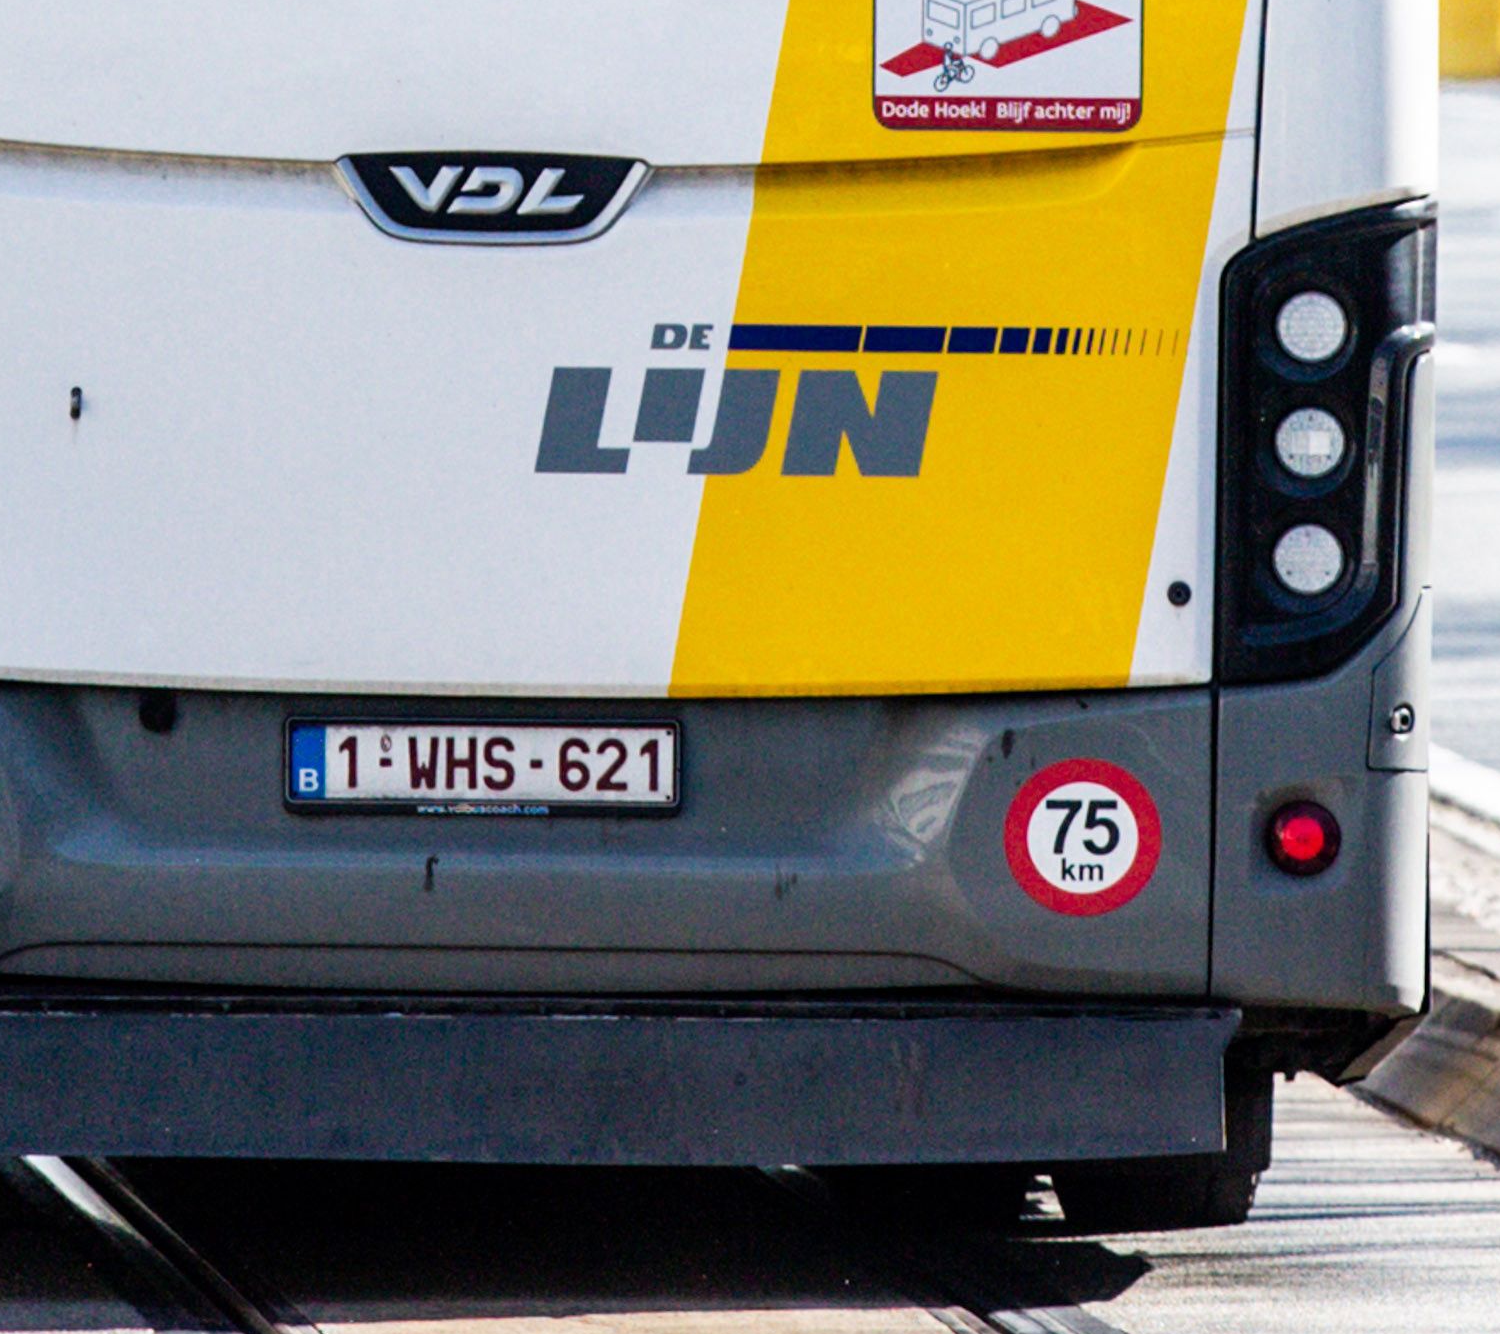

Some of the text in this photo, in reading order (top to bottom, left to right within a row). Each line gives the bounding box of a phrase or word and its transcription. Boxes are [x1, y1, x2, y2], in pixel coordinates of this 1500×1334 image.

[881, 100, 1133, 125] Dode Hoek! Blijf achter mij!
[388, 165, 585, 215] VDL
[650, 322, 713, 351] DE
[533, 366, 939, 478] LIJN
[298, 768, 319, 792] B
[338, 735, 660, 793] 1-WHS-621
[1045, 799, 1120, 856] 75
[1061, 857, 1104, 882] km
